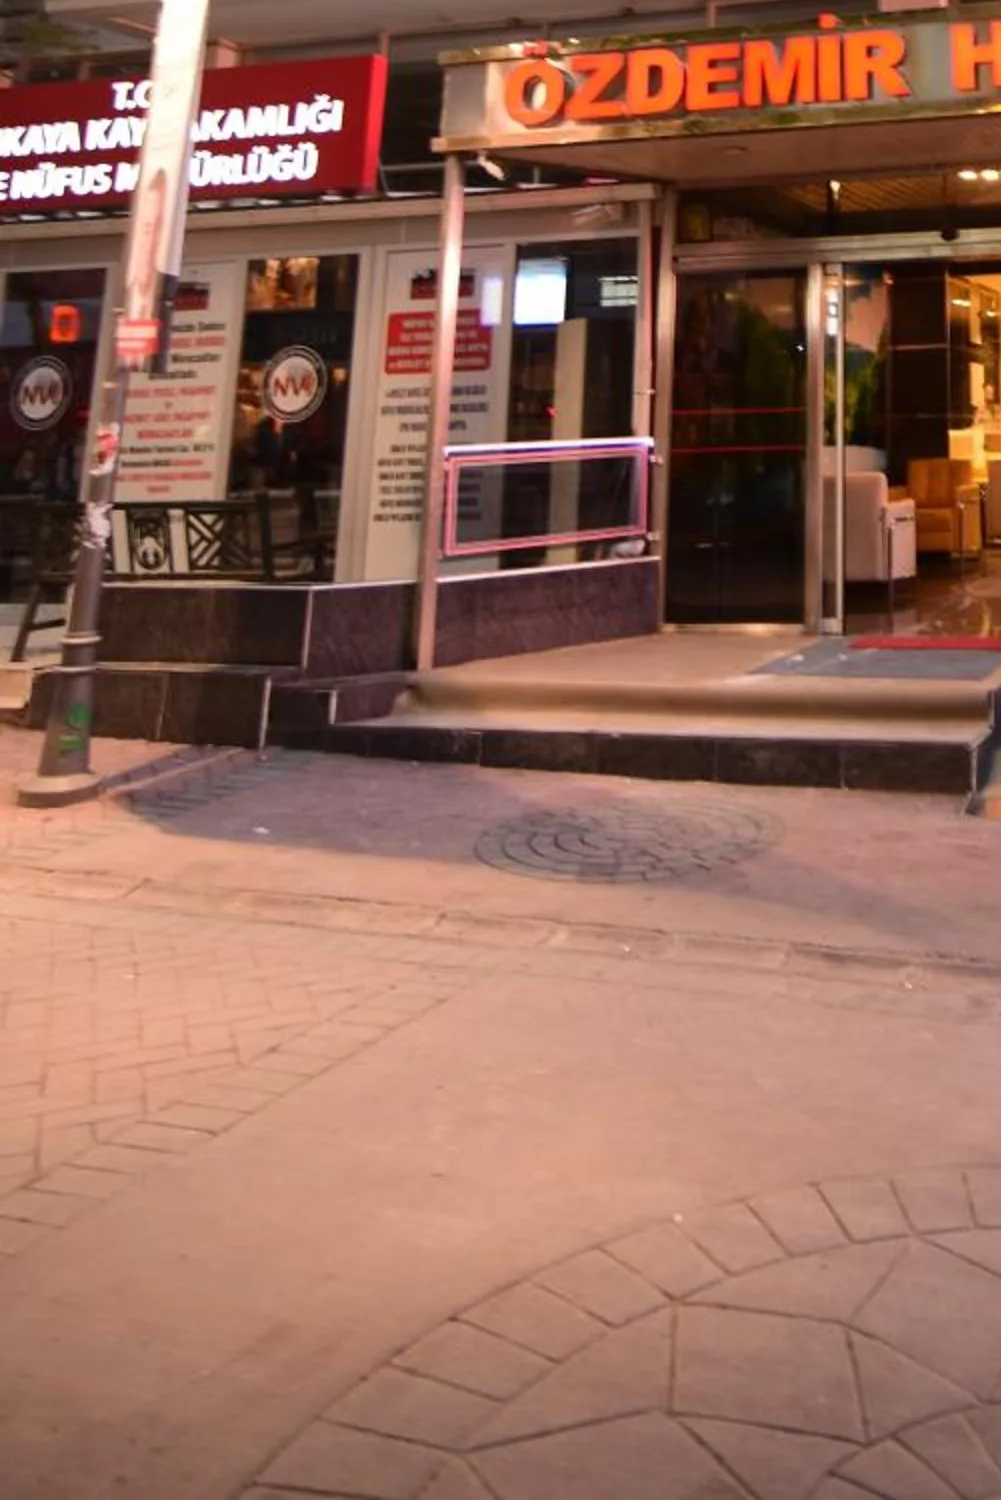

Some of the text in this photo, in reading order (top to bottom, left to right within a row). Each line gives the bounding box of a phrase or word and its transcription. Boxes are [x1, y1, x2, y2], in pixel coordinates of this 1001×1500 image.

[505, 10, 910, 128] ÖZDEMİR
[85, 94, 345, 150] KAYAKAMLIĞI
[114, 142, 319, 192] MÜRLÜĞÜ
